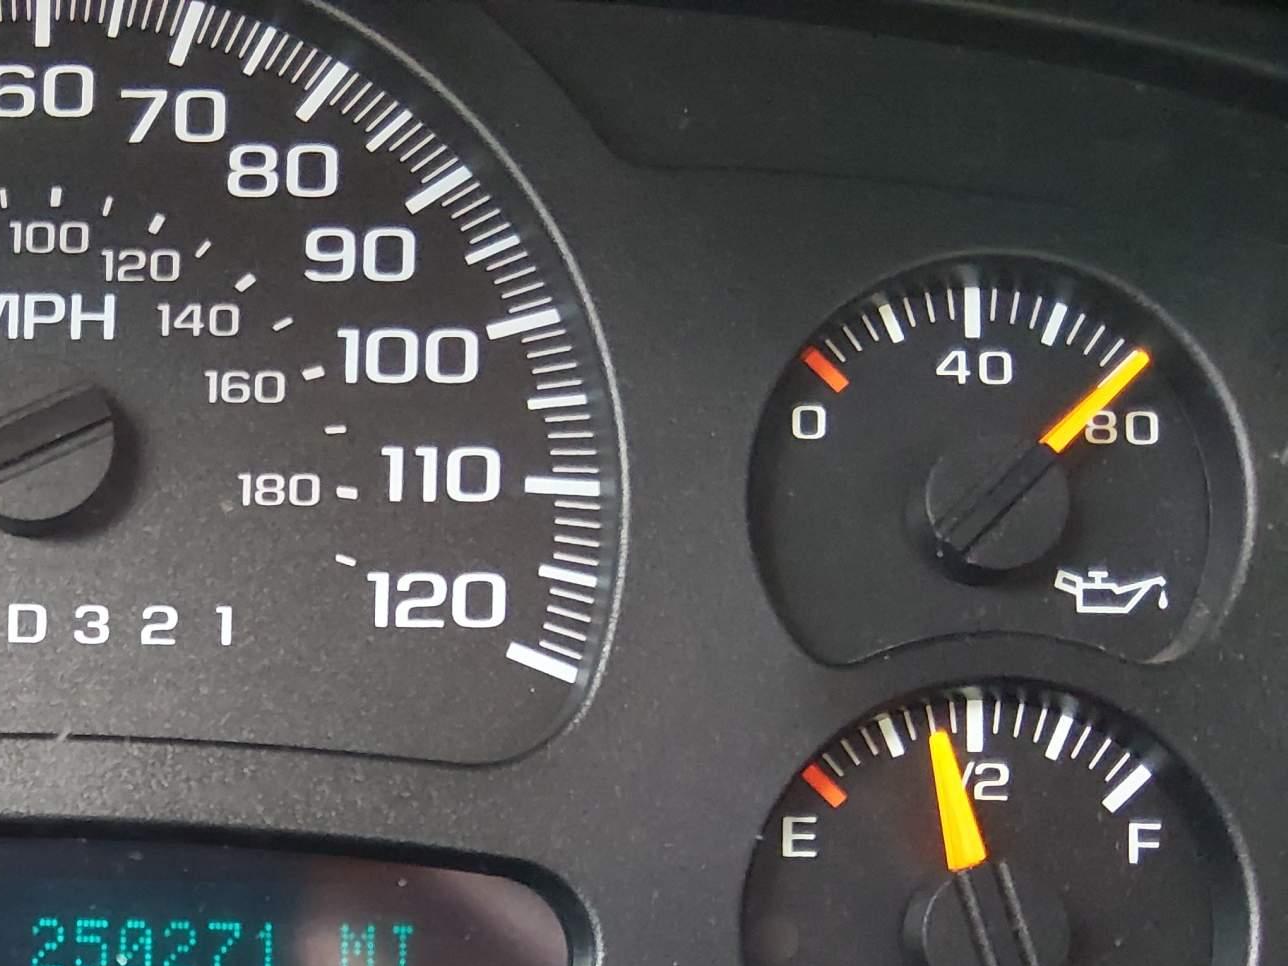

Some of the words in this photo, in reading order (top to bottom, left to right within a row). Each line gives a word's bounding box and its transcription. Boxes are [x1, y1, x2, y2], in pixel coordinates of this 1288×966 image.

[120, 89, 226, 144] 70
[226, 144, 339, 198] 80
[10, 220, 90, 255] 100
[304, 227, 417, 282] 90
[102, 249, 180, 283] 120
[157, 303, 240, 337] 140
[336, 328, 480, 384] 100
[935, 350, 1013, 386] 40
[204, 370, 286, 404] 160
[791, 404, 827, 441] 0
[1084, 409, 1159, 446] 80
[237, 473, 321, 508] 180
[380, 446, 502, 503] 110
[367, 571, 508, 630] 120
[8, 603, 48, 644] D
[73, 604, 110, 645] 3
[140, 605, 178, 646] 2
[215, 605, 234, 646] 1
[781, 817, 818, 858] E
[1127, 822, 1162, 864] F
